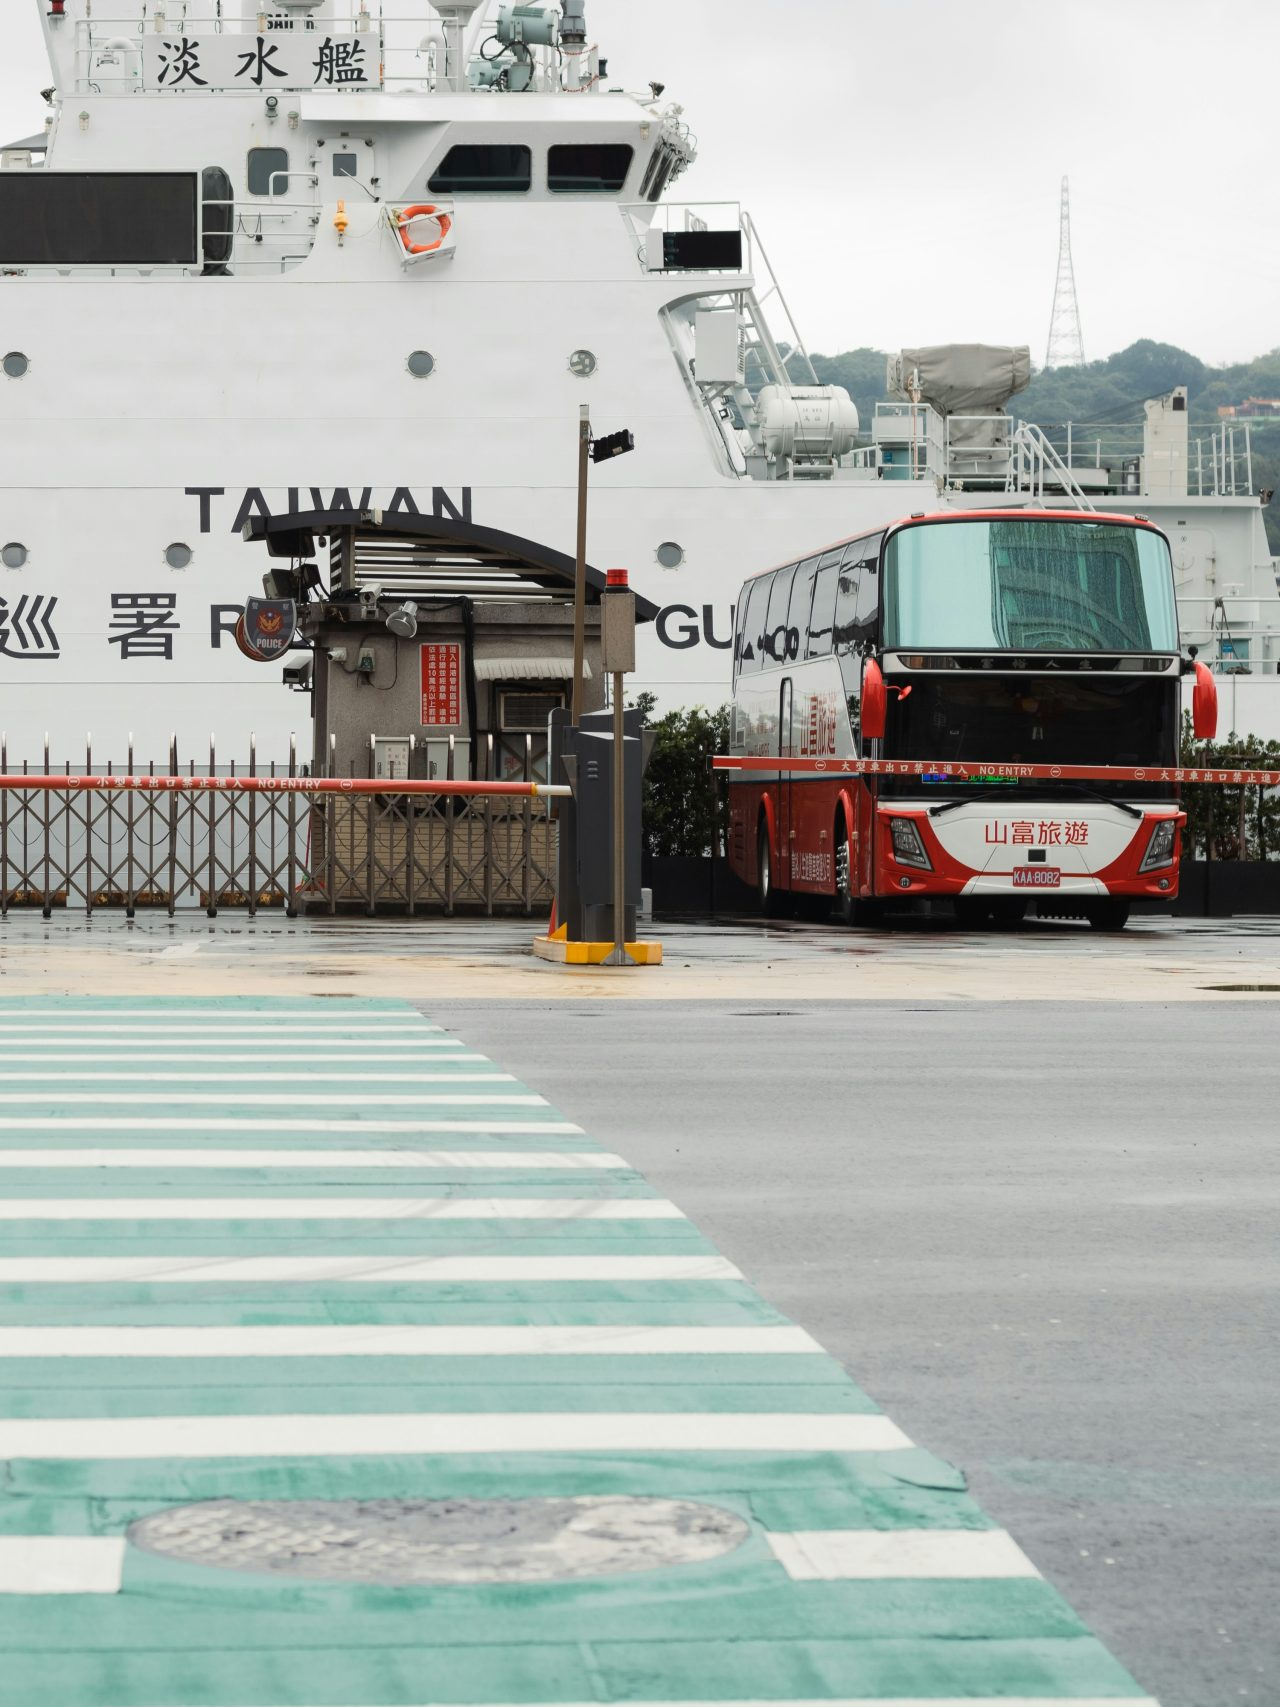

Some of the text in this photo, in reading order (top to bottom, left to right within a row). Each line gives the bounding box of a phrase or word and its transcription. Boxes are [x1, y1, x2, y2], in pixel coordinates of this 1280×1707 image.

[157, 36, 369, 86] 淡水艦
[256, 639, 282, 649] POLICE
[841, 761, 1034, 777] 大型車出口禁止進入 NO ENTRY
[97, 776, 320, 790] 小型車出口禁止進入 NO ENTRY
[985, 820, 1089, 846] 山富旅遊
